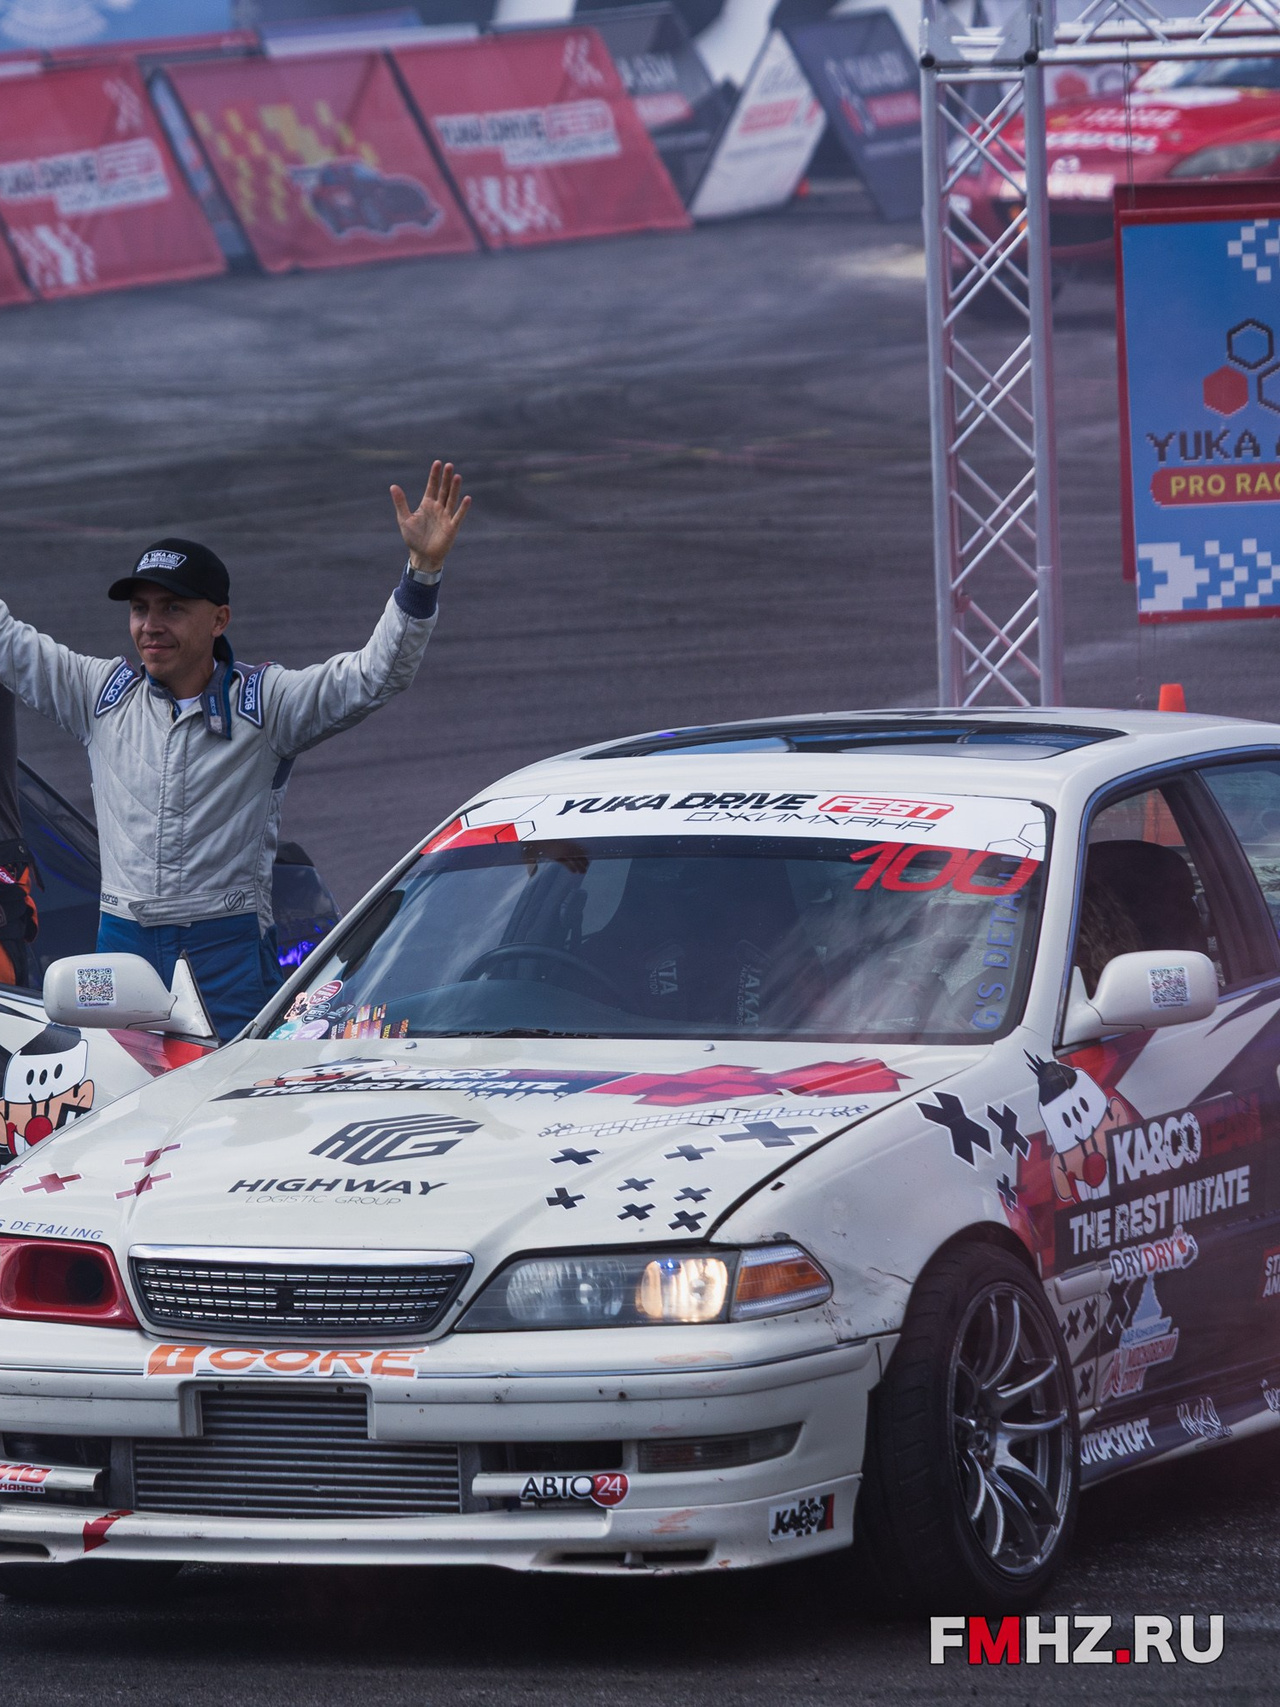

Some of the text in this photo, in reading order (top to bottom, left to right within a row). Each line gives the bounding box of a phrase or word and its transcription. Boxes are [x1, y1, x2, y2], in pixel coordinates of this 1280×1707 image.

[1146, 428, 1261, 464] YUKA
[1170, 473, 1226, 498] PRO
[107, 668, 133, 703] sparco
[245, 673, 258, 711] sparco
[556, 792, 949, 820] YUKA DRIVE FEST
[683, 811, 939, 833] ДЖИМХАНА
[849, 842, 1042, 896] 100
[100, 892, 119, 904] parco
[971, 981, 1005, 1030] G'S
[249, 1082, 323, 1097] THE
[227, 1178, 449, 1196] HIGHWAY
[244, 1194, 402, 1206] LOGISTIC GROUP
[1070, 1208, 1111, 1255] THE
[1173, 1165, 1251, 1225] IMITATE
[10, 1219, 104, 1240] DETAILING
[1112, 1239, 1177, 1280] DRYDRY
[1080, 1417, 1155, 1466] ОТОРСПОРТ
